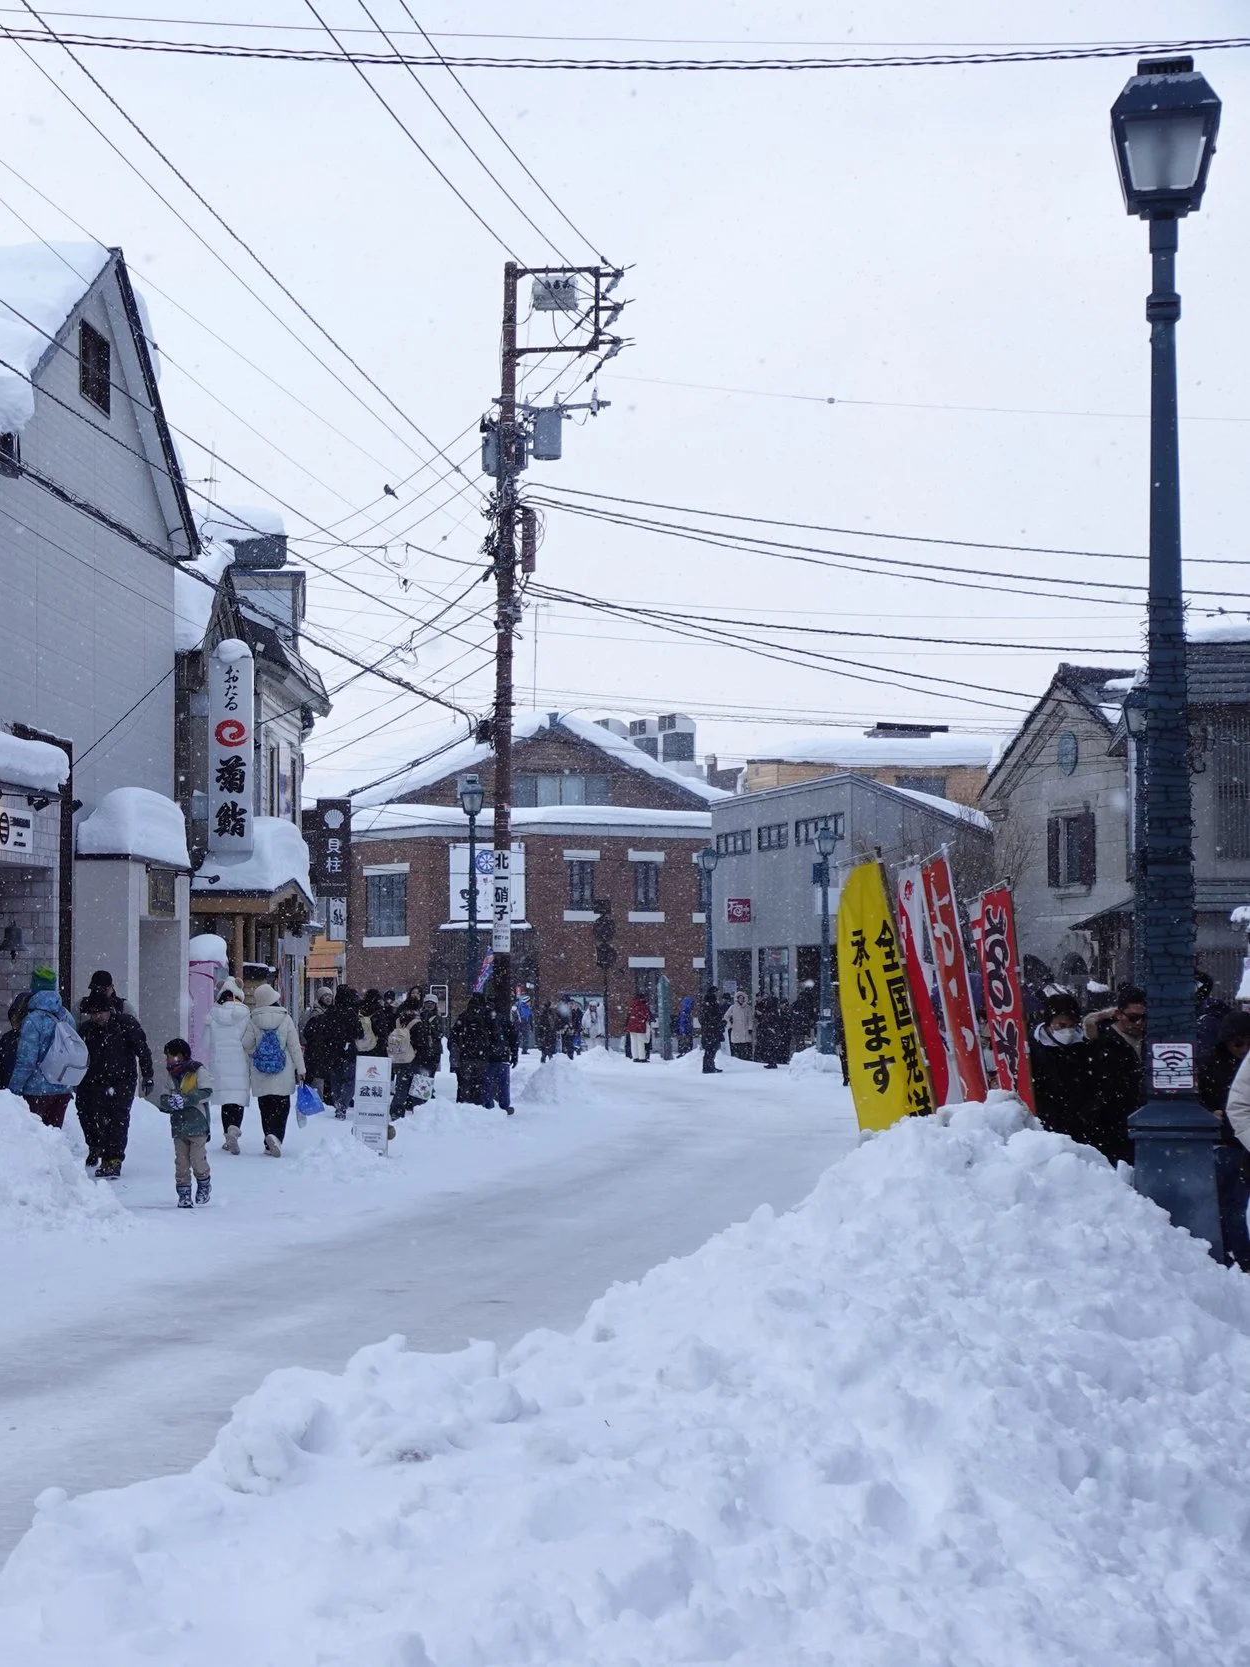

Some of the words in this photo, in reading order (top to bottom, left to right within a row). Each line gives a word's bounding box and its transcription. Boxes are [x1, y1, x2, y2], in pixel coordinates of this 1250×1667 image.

[223, 665, 240, 711] おたる
[325, 838, 342, 873] 貝柱
[494, 851, 510, 921] 北一硝子
[850, 928, 898, 1095] 承ります
[875, 919, 933, 1119] 全国発送
[359, 1085, 383, 1098] 盆栽
